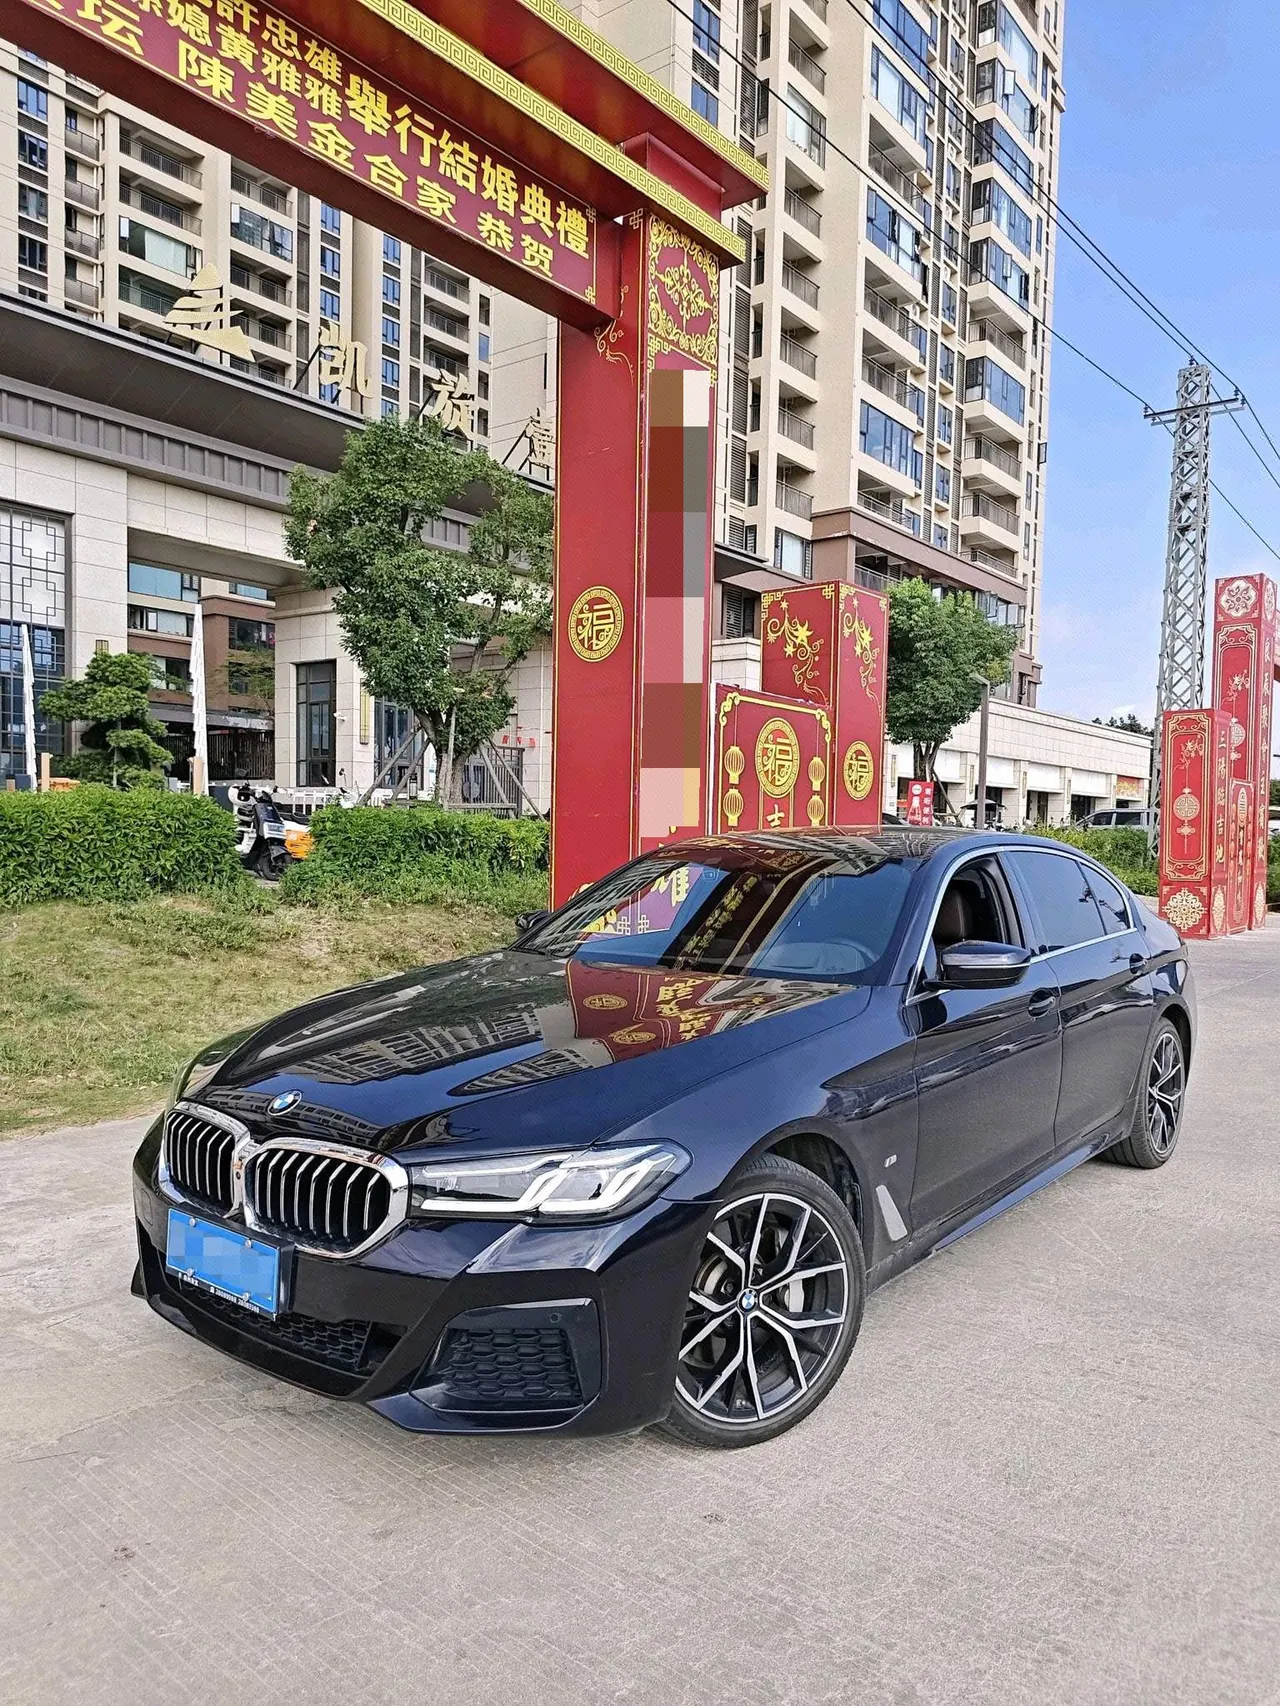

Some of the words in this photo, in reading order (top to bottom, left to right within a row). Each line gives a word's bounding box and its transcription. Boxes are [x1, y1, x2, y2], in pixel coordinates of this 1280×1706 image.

[179, 38, 457, 224] 陳美金合家
[477, 210, 554, 280] 恭贺
[344, 72, 590, 260] 舉行結婚典禮
